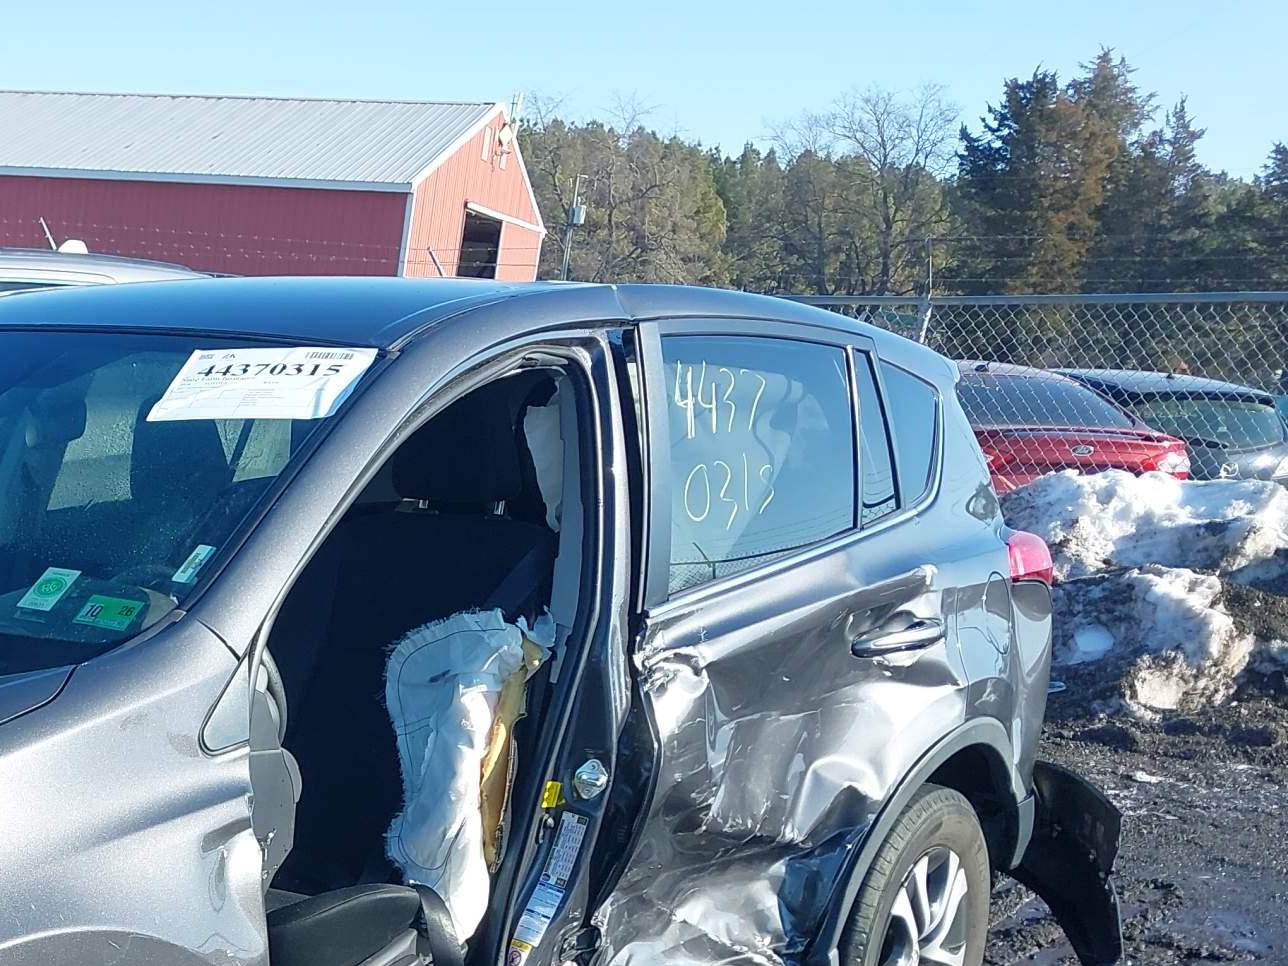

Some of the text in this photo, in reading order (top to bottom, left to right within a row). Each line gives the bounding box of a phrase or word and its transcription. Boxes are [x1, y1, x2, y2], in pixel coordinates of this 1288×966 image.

[197, 362, 345, 377] 44370315
[675, 360, 766, 439] 4437
[84, 604, 136, 618] 10 26
